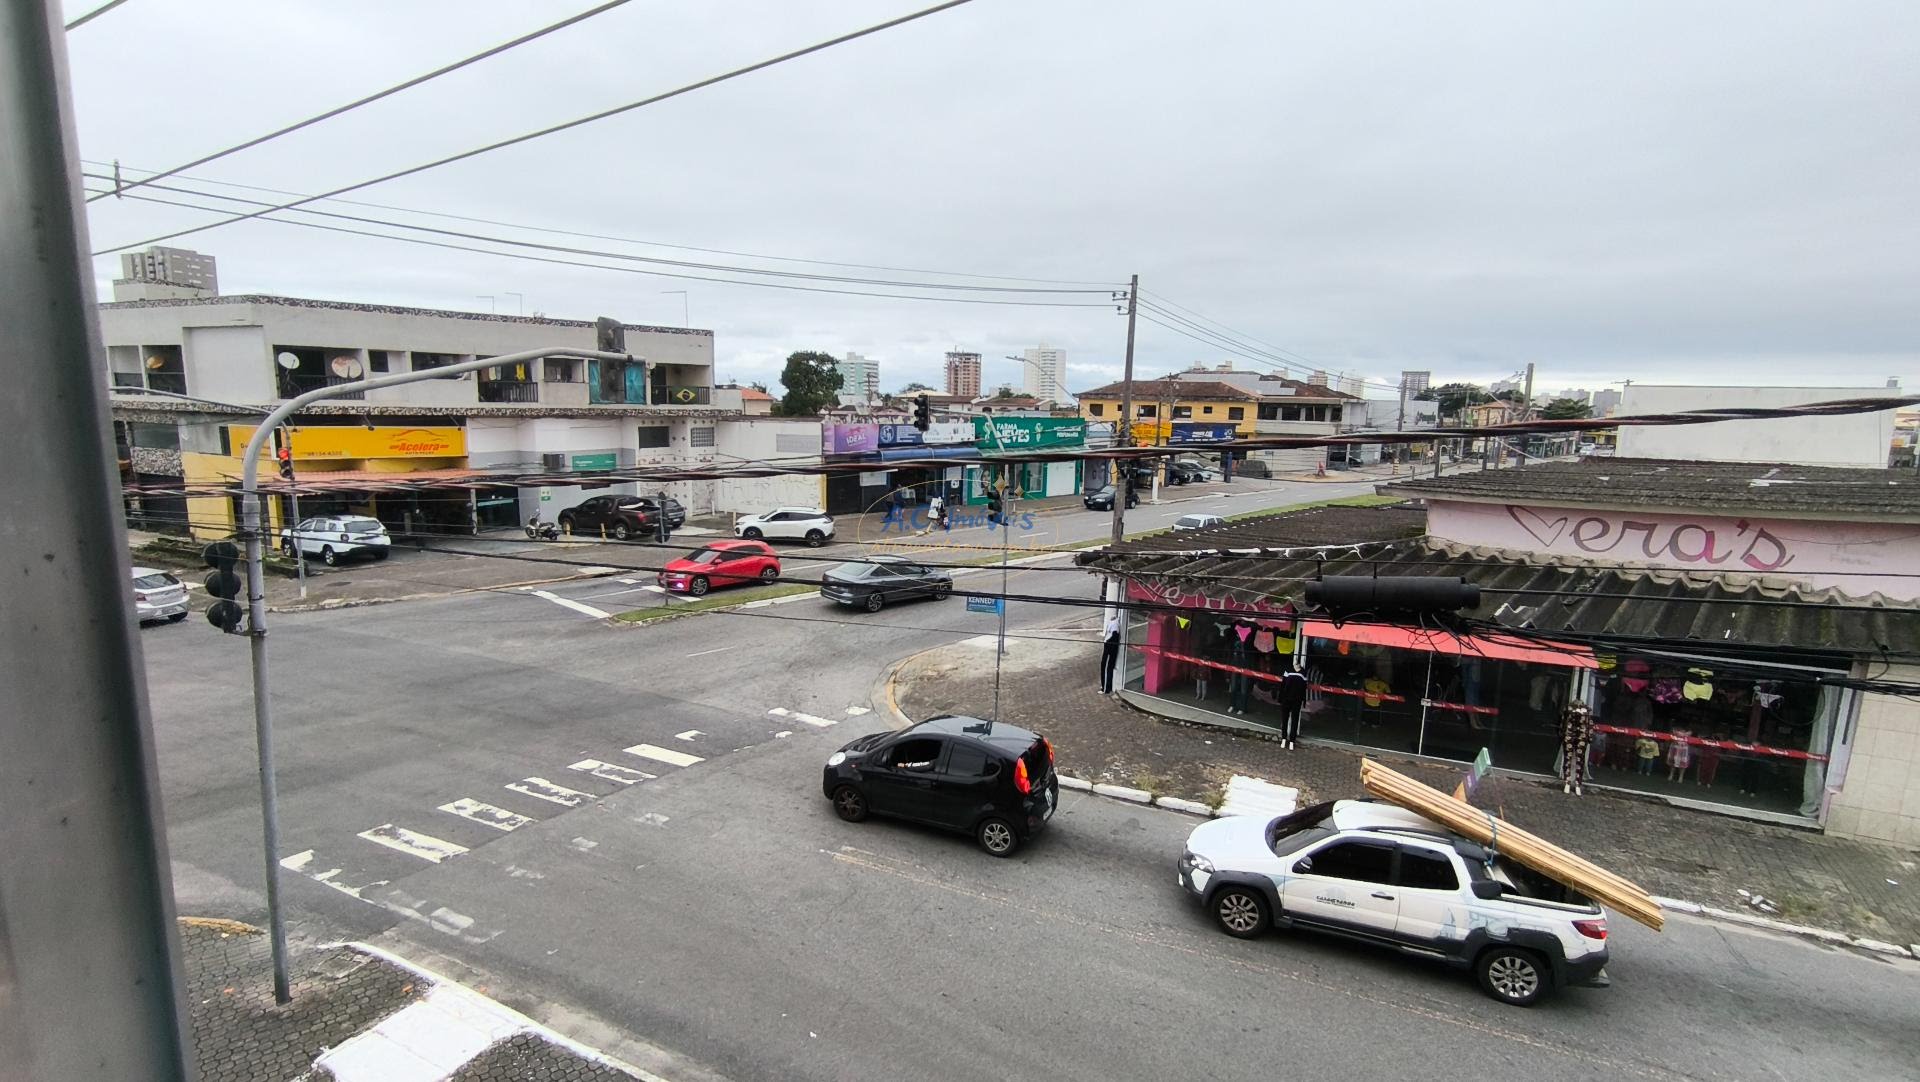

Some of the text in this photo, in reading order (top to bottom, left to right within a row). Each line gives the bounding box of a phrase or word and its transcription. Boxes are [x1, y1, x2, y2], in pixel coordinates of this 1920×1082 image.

[996, 423, 1018, 431] FARMA
[846, 433, 866, 444] IDEAL
[968, 596, 995, 605] KENNEDY
